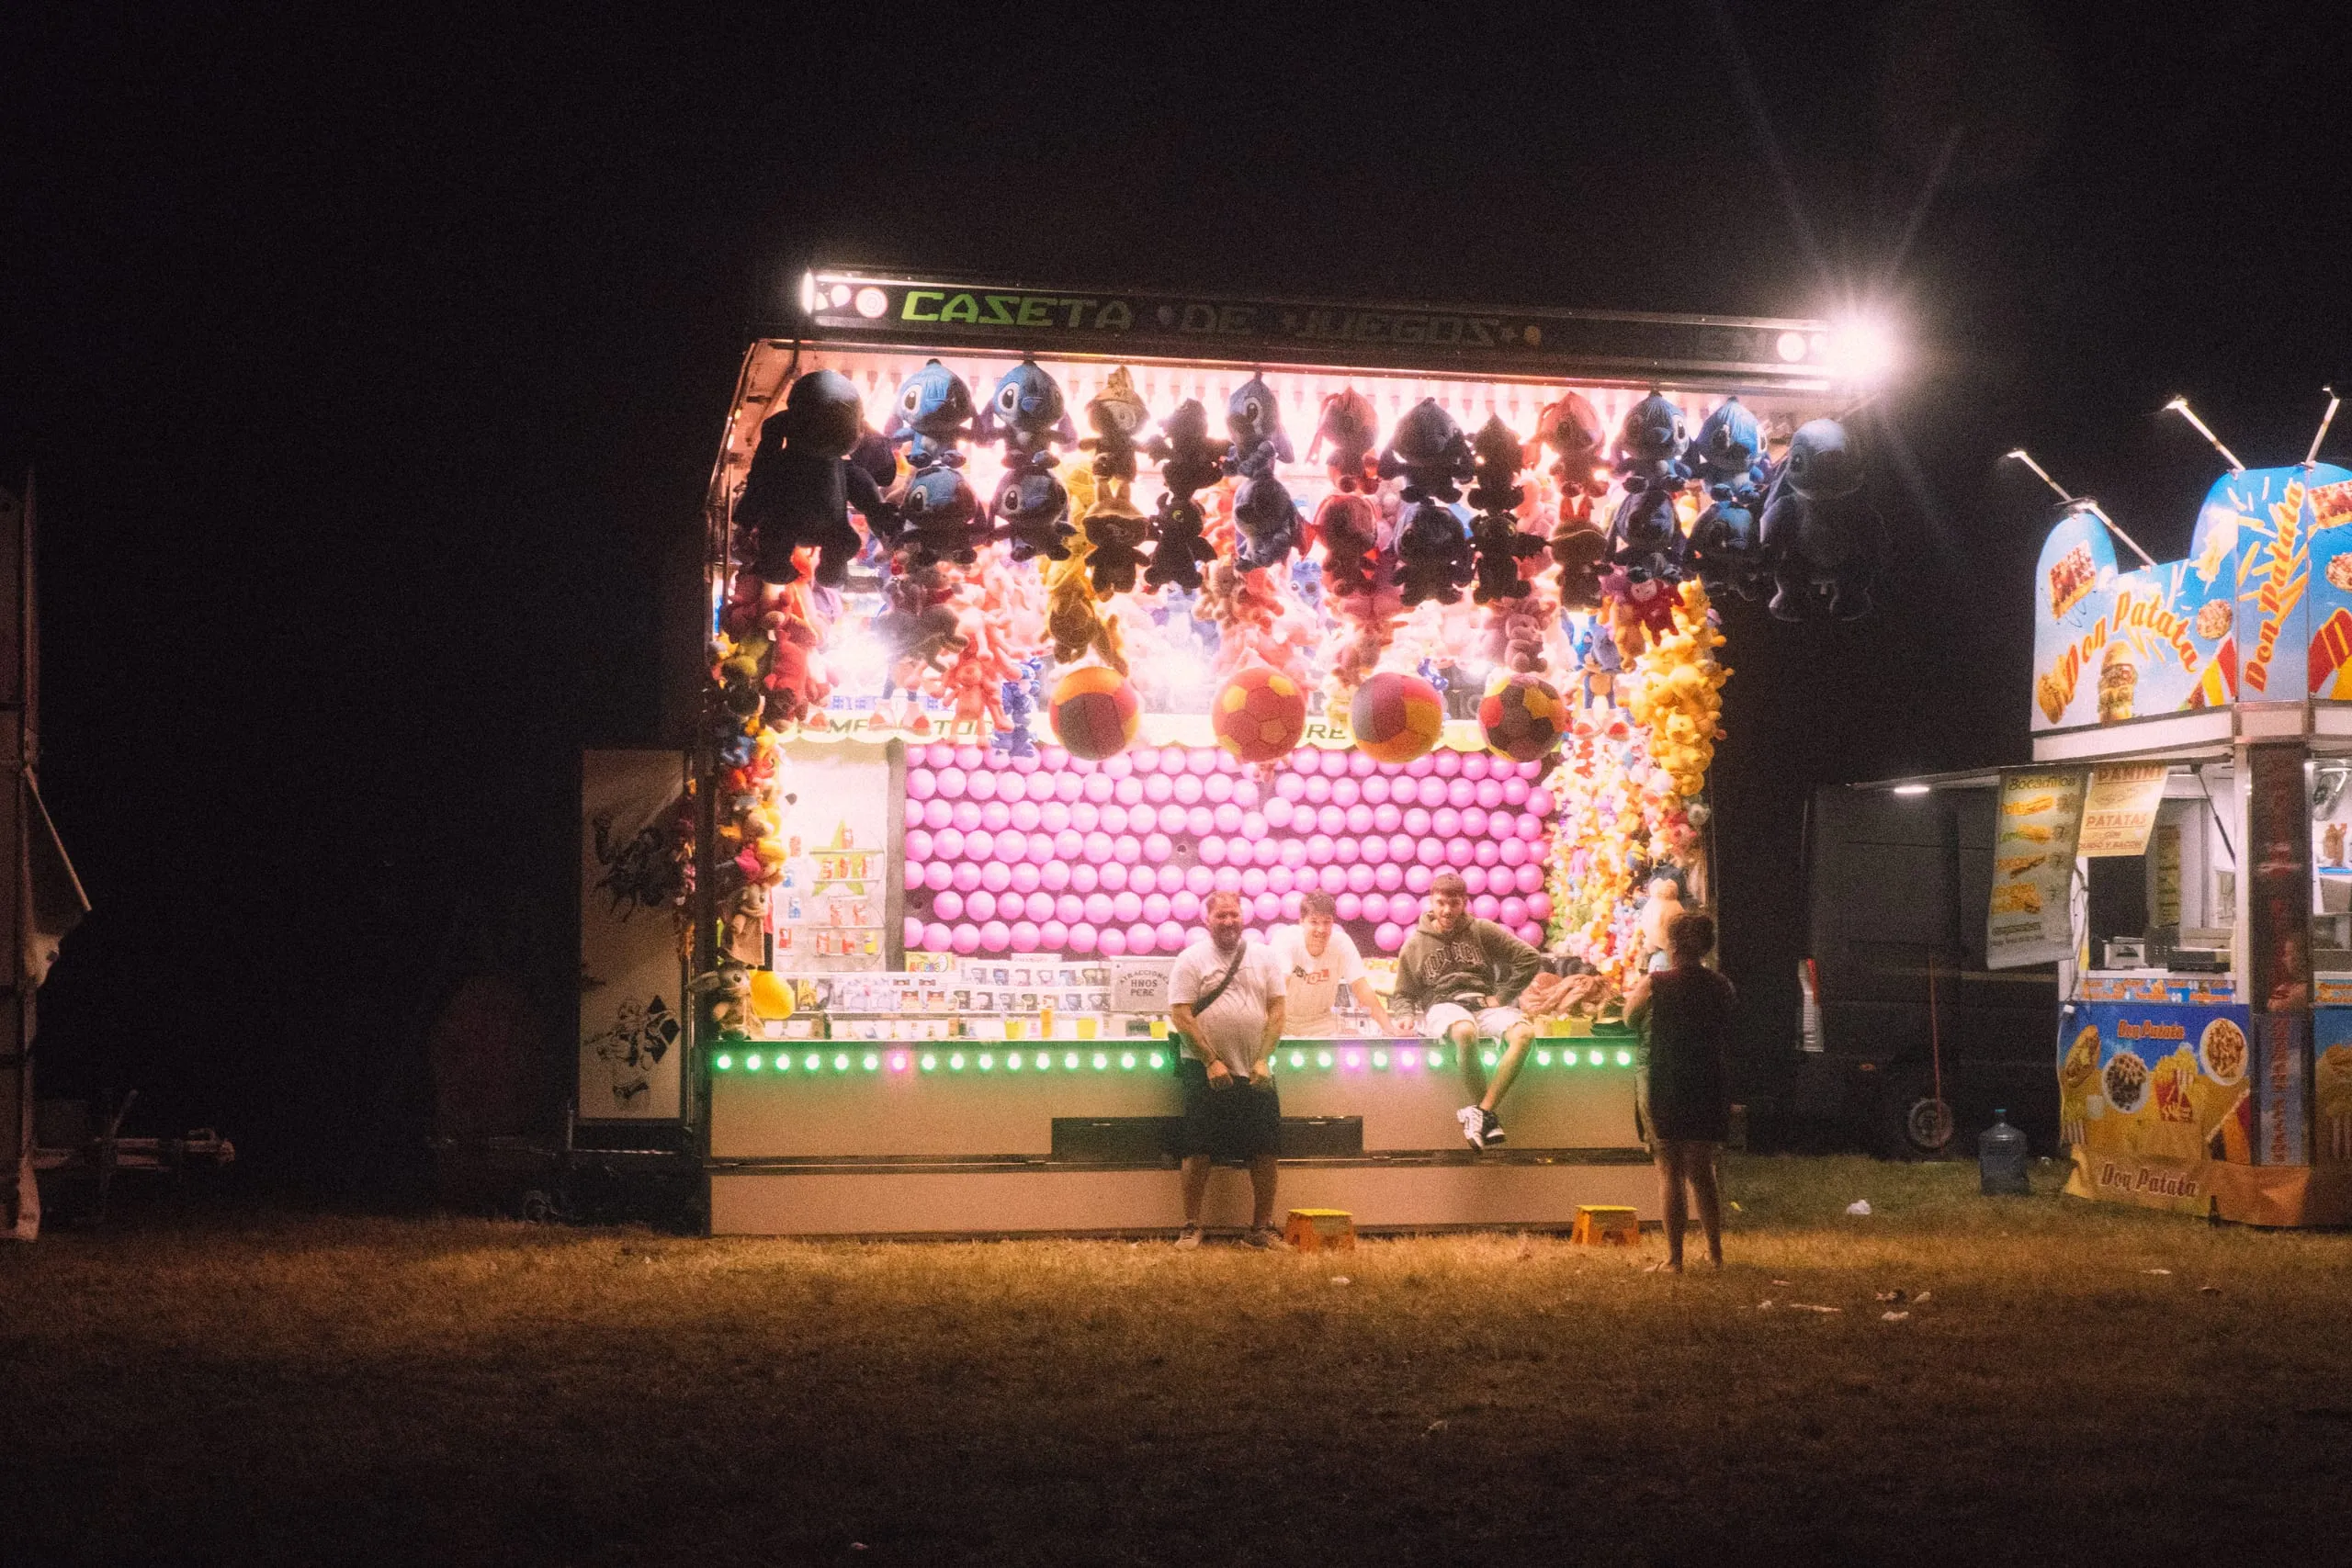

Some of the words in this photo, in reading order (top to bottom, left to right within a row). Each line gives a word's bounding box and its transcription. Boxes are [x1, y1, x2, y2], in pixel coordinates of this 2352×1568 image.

[900, 289, 1134, 330] CASETA
[1179, 303, 1258, 335] DE
[1295, 310, 1501, 347] JUEGOS
[2261, 482, 2305, 613] Patata
[2064, 615, 2108, 698] Don
[2112, 591, 2202, 672] Patata
[2245, 620, 2279, 692] Don
[2086, 813, 2147, 828] PATATAS
[1131, 979, 1158, 987] HNOS
[2100, 1162, 2132, 1191] Don
[2135, 1167, 2197, 1197] Patata
